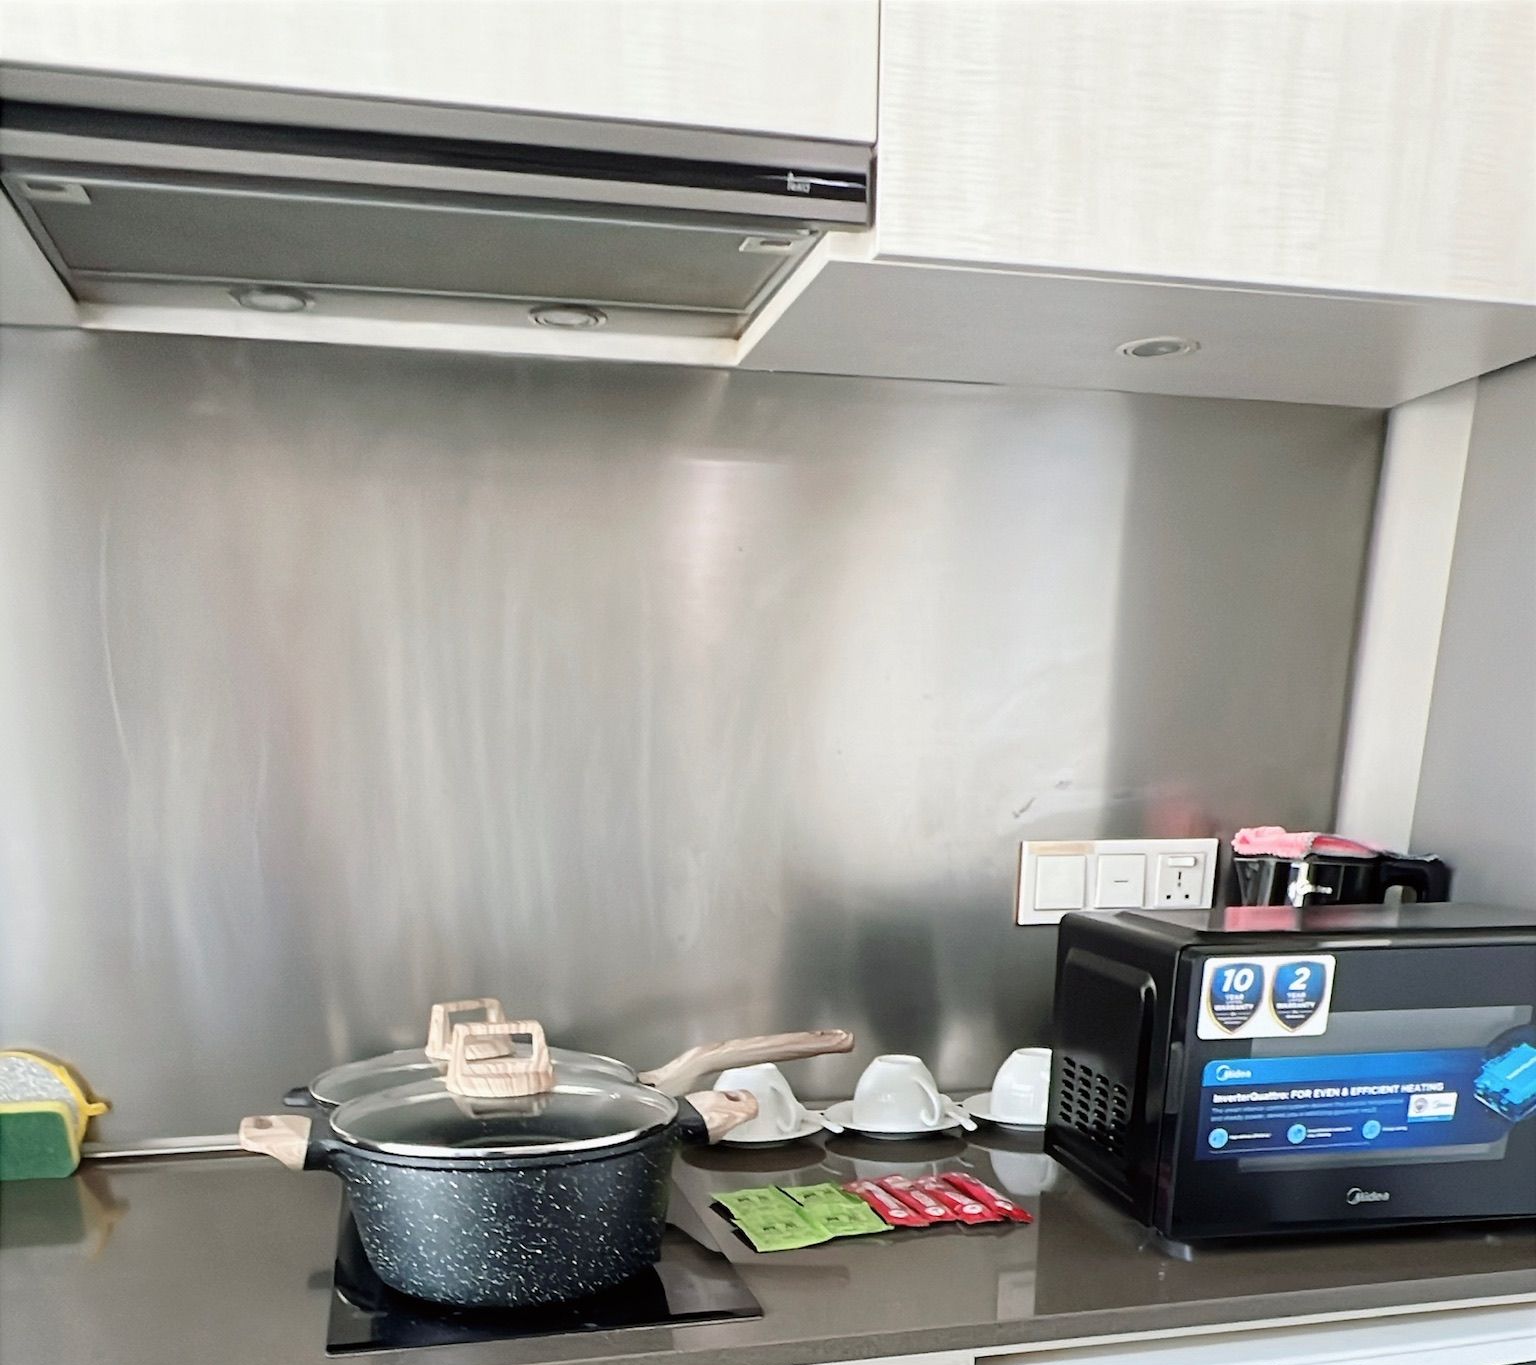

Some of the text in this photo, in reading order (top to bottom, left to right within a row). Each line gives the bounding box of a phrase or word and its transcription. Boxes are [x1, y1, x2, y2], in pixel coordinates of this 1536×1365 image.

[1222, 967, 1254, 992] 10
[1288, 966, 1311, 991] 2
[1213, 1003, 1255, 1011] WARRANTY
[1275, 1001, 1317, 1009] WARRANTY
[1290, 1089, 1312, 1099] FOR
[1313, 1087, 1340, 1098] EVEN
[1350, 1084, 1400, 1096] EFFICIENT
[1400, 1082, 1445, 1094] HEATING
[1346, 1187, 1390, 1205] Midea
